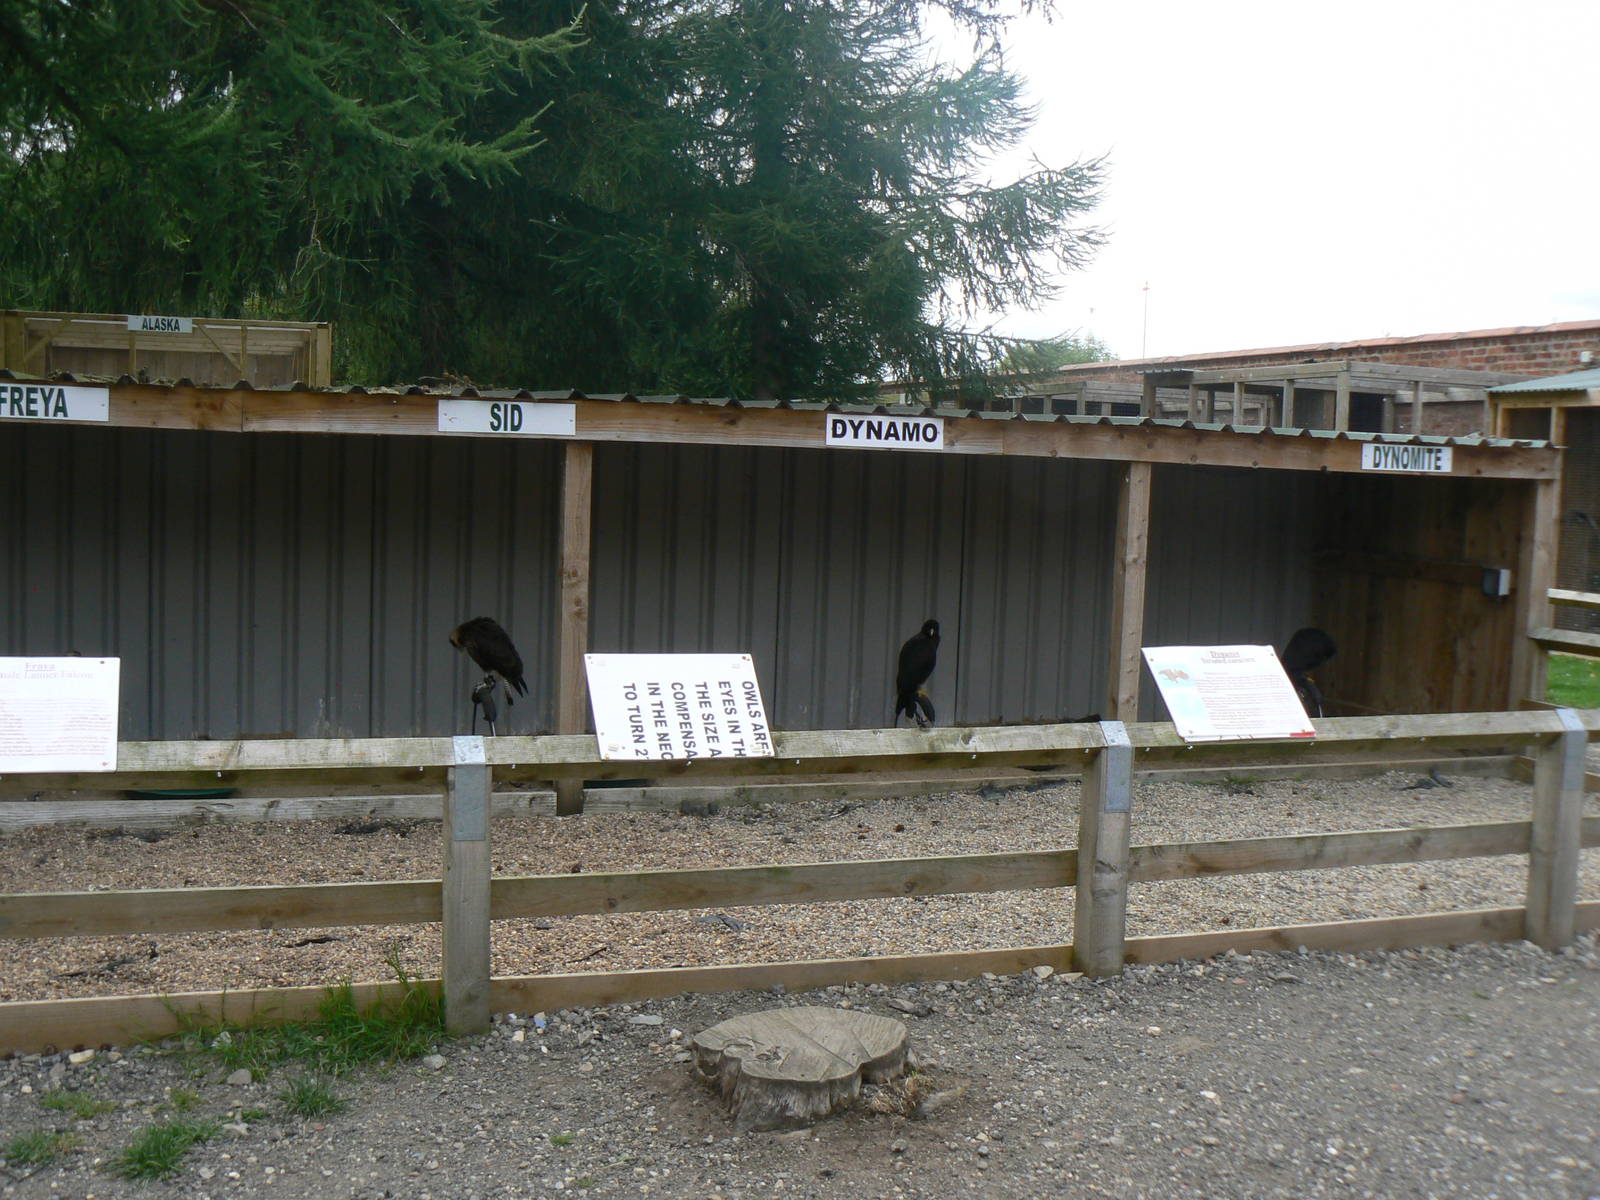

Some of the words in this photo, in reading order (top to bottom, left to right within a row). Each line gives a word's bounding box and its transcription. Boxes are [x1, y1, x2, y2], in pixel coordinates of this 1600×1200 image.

[142, 318, 180, 331] ALASKA
[0, 386, 69, 417] FREYA
[490, 403, 523, 431] SID
[832, 418, 938, 442] DYNAMO
[1373, 446, 1442, 470] DYNOMITE
[623, 683, 638, 700] TO
[647, 682, 661, 696] IN
[695, 682, 712, 708] THE
[718, 681, 737, 715] EYES
[742, 681, 761, 718] OWLS
[627, 705, 646, 743] TURN
[651, 700, 667, 727] THE
[671, 682, 698, 760] COMPENSA
[727, 720, 742, 734] IN
[702, 713, 720, 743] SIZE
[656, 733, 674, 760] NEC
